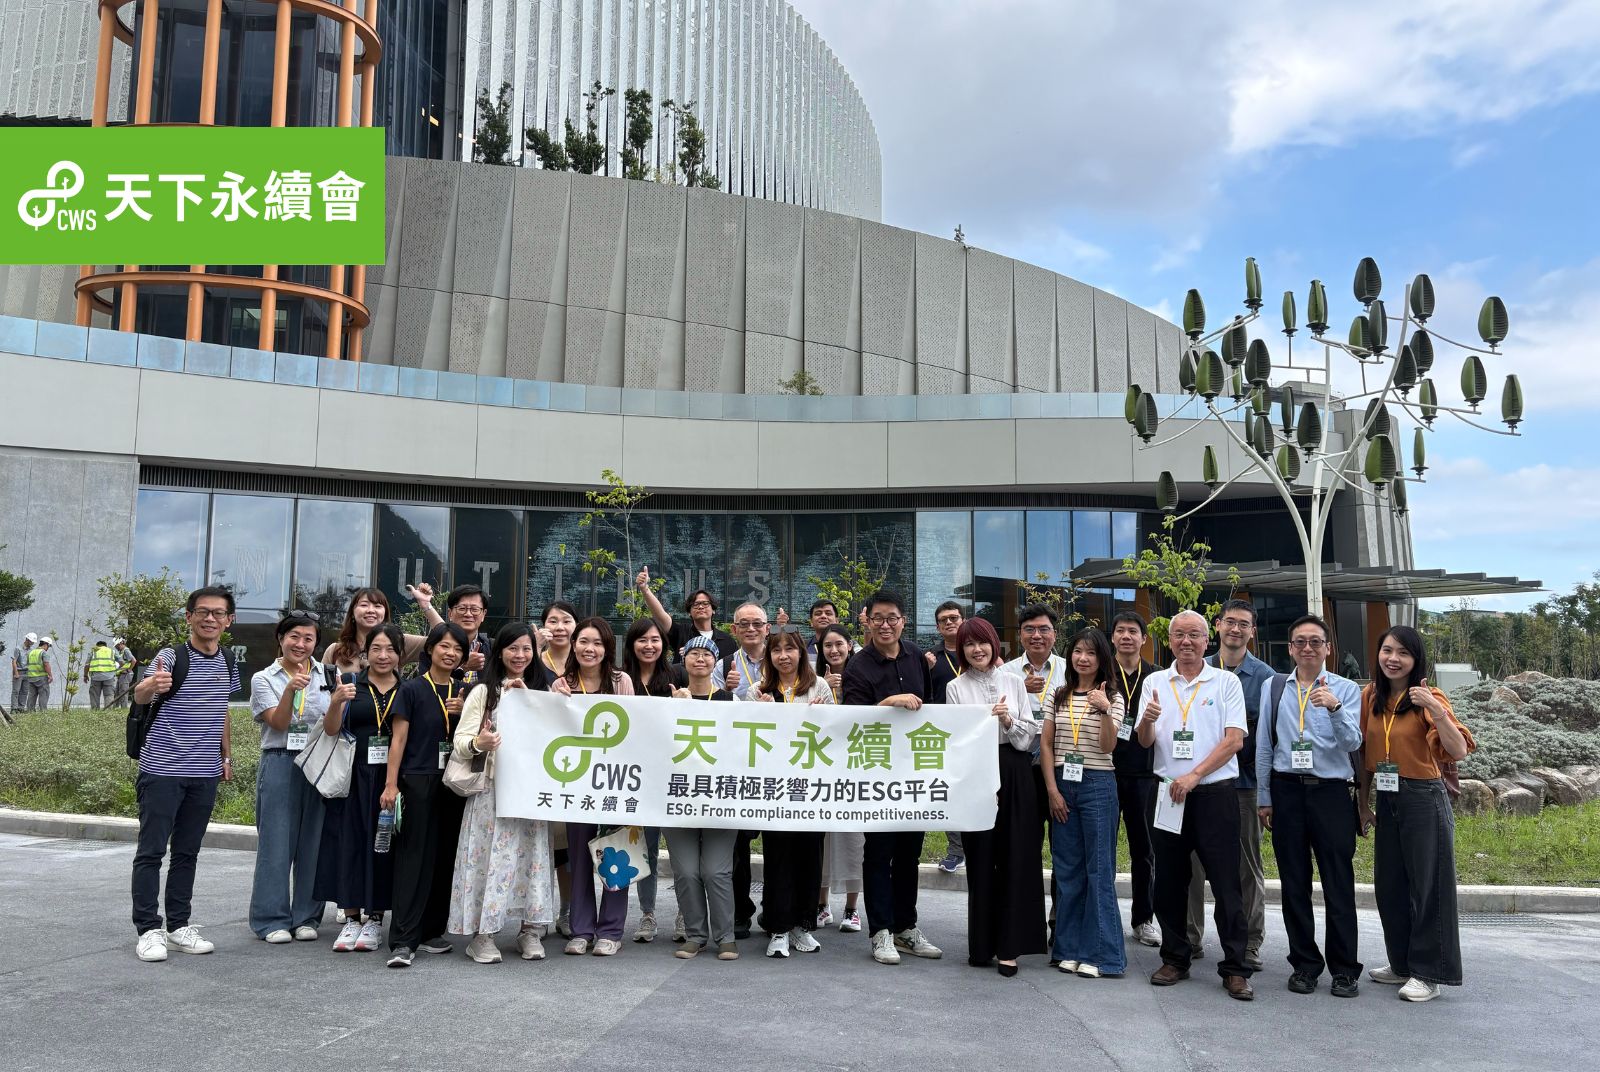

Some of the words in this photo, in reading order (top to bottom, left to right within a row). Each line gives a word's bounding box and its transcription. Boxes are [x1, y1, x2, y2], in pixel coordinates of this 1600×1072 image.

[671, 718, 951, 771] 天下永續會
[591, 763, 642, 792] CWS
[667, 773, 949, 803] 最具積極影響力的ESG平台
[537, 791, 640, 813] 天下永續會
[666, 803, 697, 816] ESG:
[701, 804, 736, 818] From
[739, 806, 816, 821] compliance
[819, 808, 832, 820] to
[835, 808, 949, 823] competitiveness.
